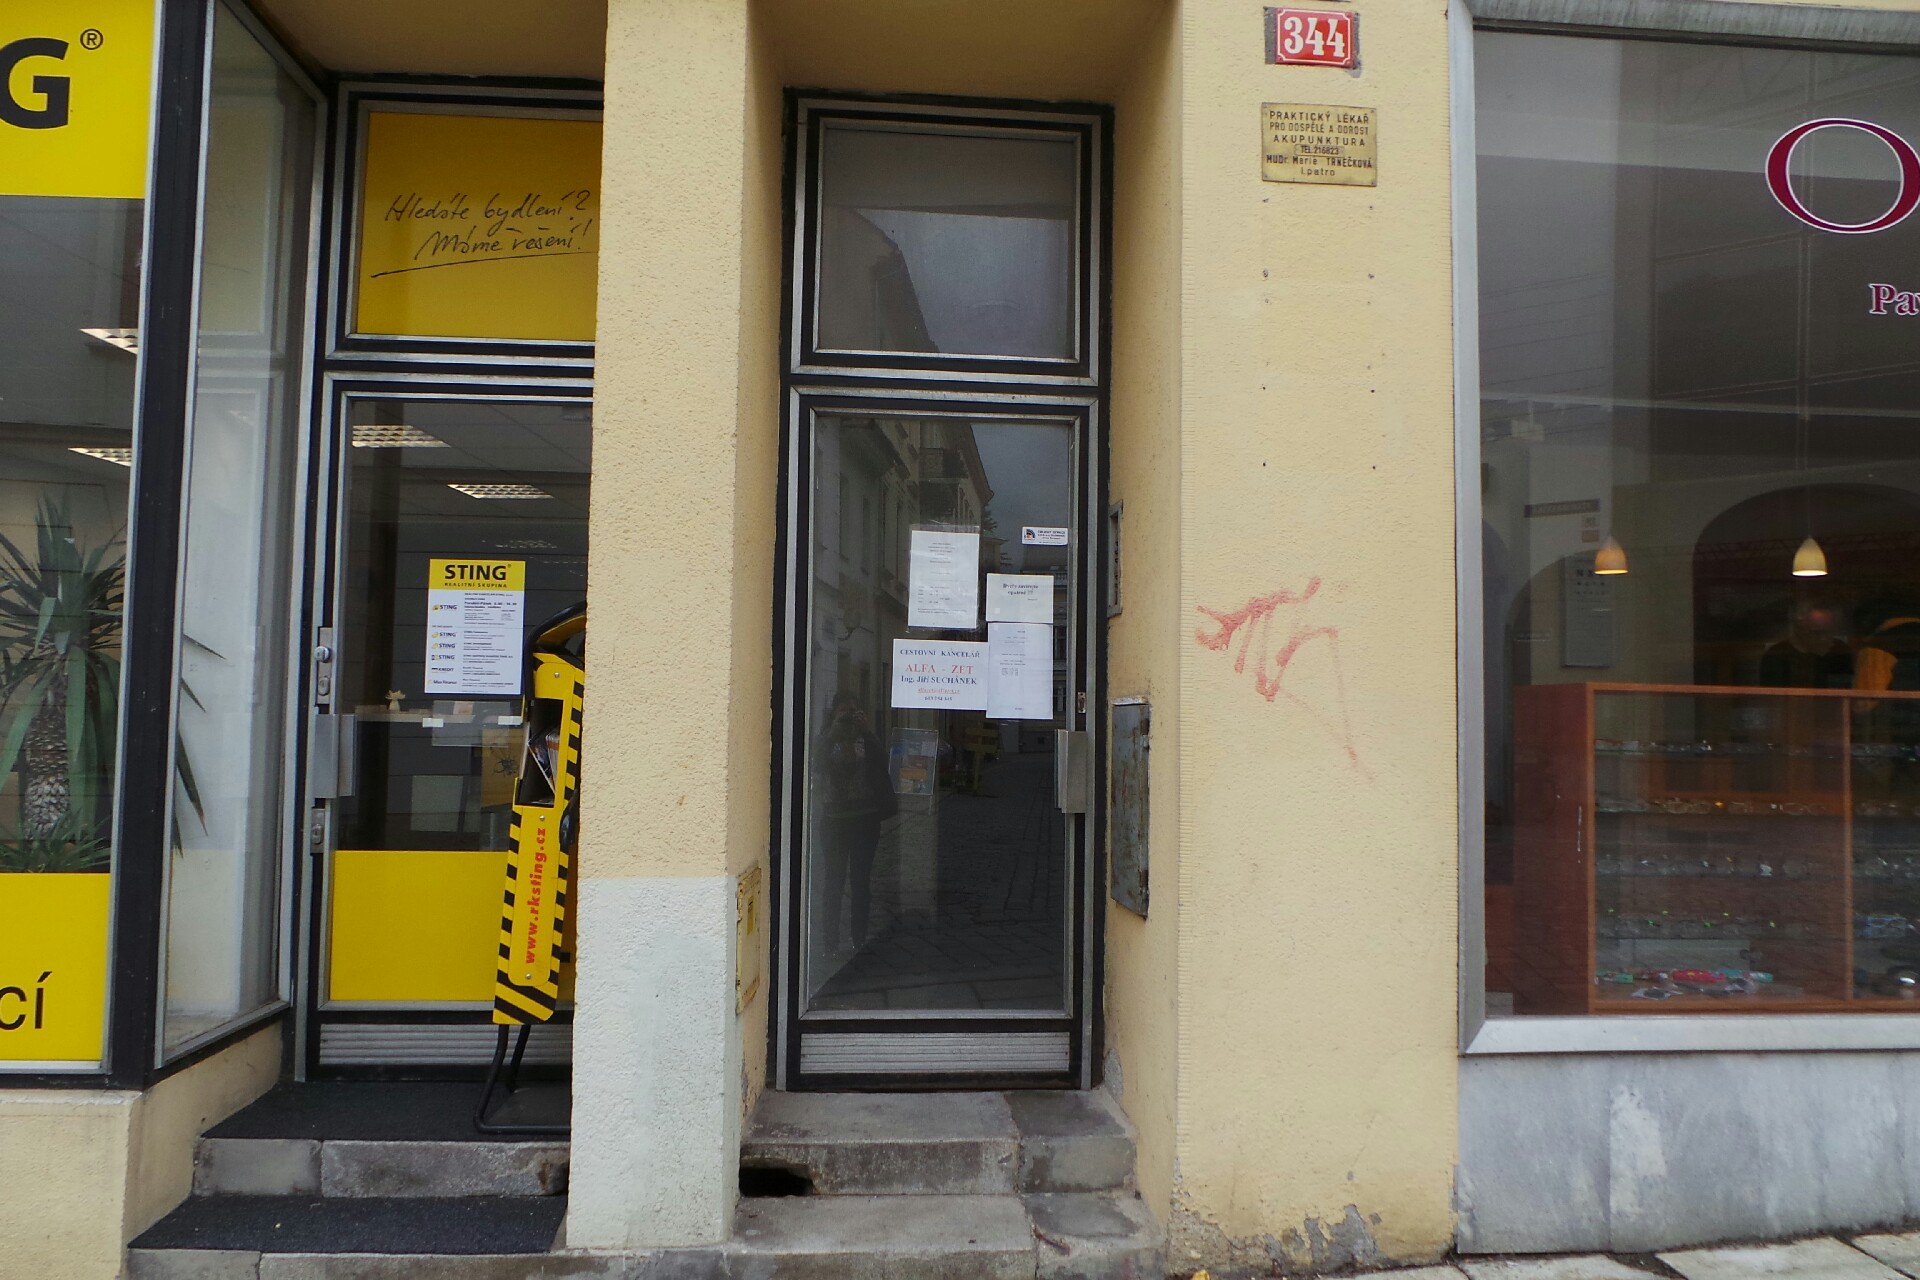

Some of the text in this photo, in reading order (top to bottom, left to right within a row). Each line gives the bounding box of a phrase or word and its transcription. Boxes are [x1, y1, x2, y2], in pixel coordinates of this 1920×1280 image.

[1283, 16, 1345, 58] 344
[1269, 110, 1369, 124] PRAKTICKÝ LÉKAŘ
[1269, 121, 1369, 135] PRO DOSPĚLÉ A DOROST
[1273, 134, 1366, 146] AKUPUNKTURA
[1292, 156, 1318, 165] Marie
[1326, 156, 1373, 168] TRNEČKOVÁ
[385, 192, 470, 221] Hledáte
[444, 564, 507, 581] STING
[905, 663, 936, 673] ALFA
[951, 664, 974, 675] ZET
[901, 675, 915, 684] Ing.
[931, 675, 977, 685] SUCHÁNEK
[526, 827, 548, 965] www.rksting.cz
